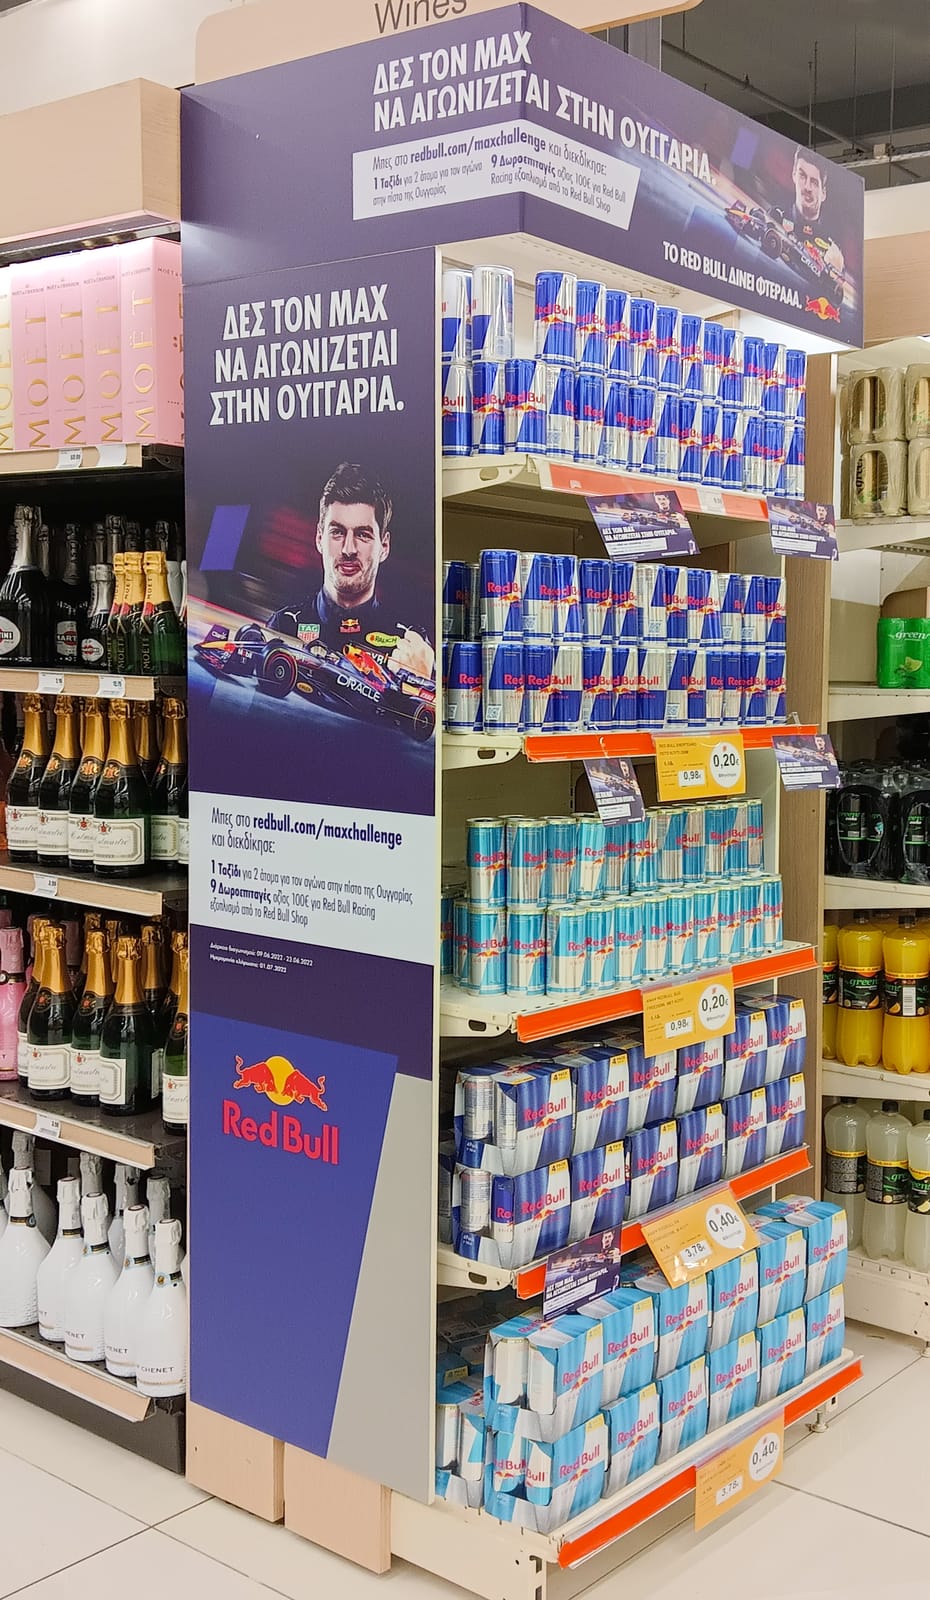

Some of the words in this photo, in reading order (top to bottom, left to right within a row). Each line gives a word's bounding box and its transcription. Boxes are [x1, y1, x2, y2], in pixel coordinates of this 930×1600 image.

[375, 0, 467, 33] Wines
[373, 55, 414, 95] ΔΕΣ
[420, 44, 467, 84] ΤΟΝ
[474, 30, 532, 72] MAX
[374, 96, 406, 132] ΝΑ
[411, 69, 550, 124] ΑΓΩΝΙΖΕΤΑΙ
[556, 85, 614, 140] ΣΤΗΝ
[620, 117, 717, 185] ΟΥΓΓΑΡΙΑ.
[373, 156, 392, 171] Μπες
[394, 154, 408, 167] στο
[410, 127, 546, 163] redbull.com/maxchallenge
[549, 142, 561, 157] και
[564, 143, 607, 176] διεκδίκησε:
[374, 177, 377, 190] 1
[381, 174, 402, 190] Ταξίδι
[403, 176, 412, 187] για
[414, 171, 418, 183] 2
[440, 169, 448, 179] για
[450, 167, 460, 176] τον
[491, 154, 498, 168] 9
[576, 173, 591, 189] 100€
[603, 184, 614, 198] Red
[615, 190, 626, 204] Bull
[491, 172, 513, 184] Racing
[570, 187, 581, 201] Red
[583, 193, 594, 206] Bull
[596, 198, 611, 214] Shop
[663, 241, 680, 265] ΤΟ
[681, 247, 702, 271] RED
[703, 253, 727, 282] BULL
[729, 267, 755, 290] ΔΙΝΕΙ
[222, 301, 266, 341] ΔΕΣ
[271, 293, 322, 334] ΤΟΝ
[329, 283, 388, 328] MAX
[215, 347, 248, 384] ΝΑ
[253, 328, 398, 380] ΑΓΩΝΙΖΕΤΑΙ
[209, 387, 270, 426] ΣΤΗΝ
[277, 374, 405, 421] ΟΥΓΓΑΡΙΑ.
[487, 582, 512, 593] Red
[336, 674, 381, 702] ORACLE
[528, 675, 550, 685] Red
[211, 807, 234, 828] Μπες
[236, 816, 250, 828] στο
[253, 813, 402, 850] redbull.com/maxchallenge
[212, 834, 225, 847] και
[228, 830, 276, 856] διεκδίκησε:
[212, 860, 215, 873] 1
[218, 863, 240, 879] Ταξίδι
[242, 870, 252, 880] για
[254, 868, 258, 880] 2
[260, 868, 279, 884] άτομα
[280, 875, 290, 886] για
[292, 876, 302, 886] τον
[304, 875, 326, 891] αγώνα
[327, 881, 343, 894] στην
[344, 880, 361, 895] πίστα
[364, 886, 375, 899] της
[377, 884, 413, 905] Ουγγαρίας
[210, 897, 240, 915] εξοπλισμό
[241, 903, 253, 916] από
[255, 908, 261, 918] το
[264, 906, 275, 920] Red
[277, 908, 289, 922] Bull
[291, 910, 308, 927] Shop
[211, 879, 216, 893] 9
[219, 882, 271, 904] Δωροεπιταγές
[292, 893, 309, 908] 100€
[311, 899, 320, 911] για
[323, 897, 335, 912] Red
[338, 899, 350, 913] Bull
[353, 902, 375, 920] Racing
[731, 1041, 748, 1053] Red
[749, 1035, 764, 1047] Bull
[771, 1029, 787, 1041] Red
[788, 1024, 803, 1035] Bull
[684, 1055, 702, 1067] Red
[702, 1050, 719, 1062] Bull
[633, 1071, 653, 1083] Red
[654, 1063, 671, 1077] Bull
[584, 1089, 605, 1102] Red
[606, 1081, 624, 1096] Bull
[523, 1107, 544, 1121] Red
[547, 1098, 567, 1114] Bull
[222, 1099, 278, 1148] Red
[282, 1115, 339, 1165] Bull
[637, 1155, 655, 1168] Red
[656, 1148, 674, 1161] Bull
[578, 1176, 601, 1192] Red
[602, 1168, 620, 1184] Bull
[521, 1200, 543, 1215] Red
[545, 1188, 565, 1204] Bull
[765, 1264, 783, 1279] Red
[783, 1255, 800, 1271] Bull
[719, 1289, 737, 1304] Red
[738, 1278, 754, 1296] Bull
[664, 1312, 685, 1327] Red
[686, 1299, 704, 1317] Bull
[607, 1339, 629, 1354] Red
[629, 1326, 649, 1343] Bull
[562, 1368, 582, 1385] Red
[582, 1354, 599, 1373] Bull
[716, 1370, 734, 1384] Red
[735, 1357, 752, 1374] Bull
[559, 1461, 580, 1477] Red
[581, 1445, 600, 1463] Bull
